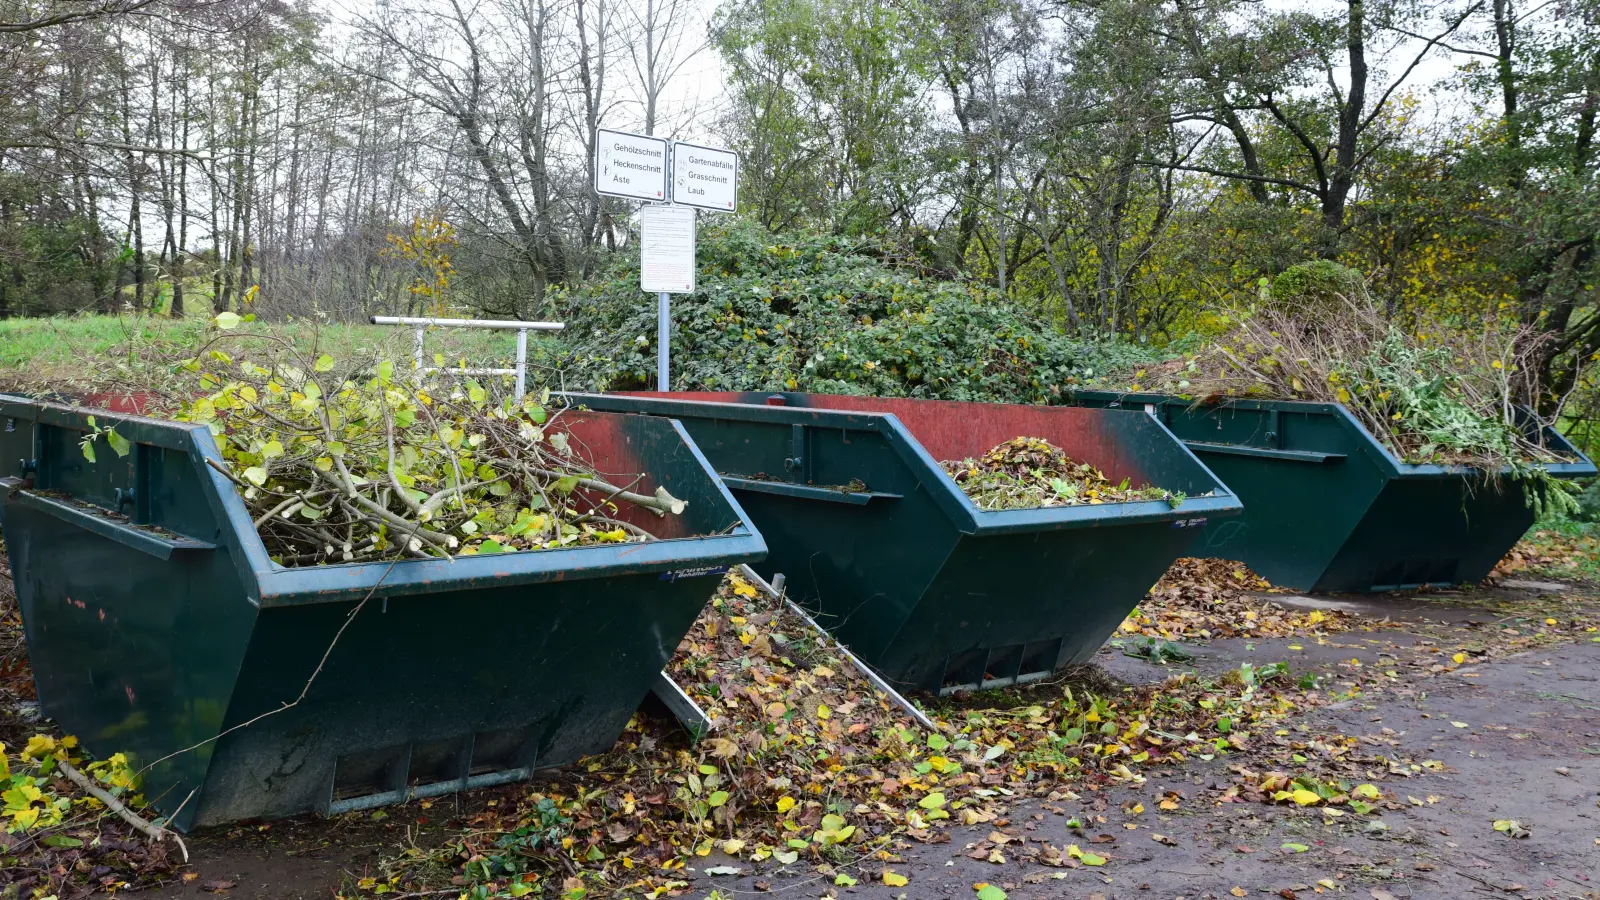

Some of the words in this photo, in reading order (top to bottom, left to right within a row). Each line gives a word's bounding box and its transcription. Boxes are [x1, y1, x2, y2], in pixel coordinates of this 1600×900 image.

[613, 143, 662, 158] Gehölzschnitt
[613, 159, 662, 173] Heckenschnitt
[688, 155, 734, 170] Gartenabfälle
[688, 171, 728, 184] Grasschnitt
[687, 186, 705, 195] Laub
